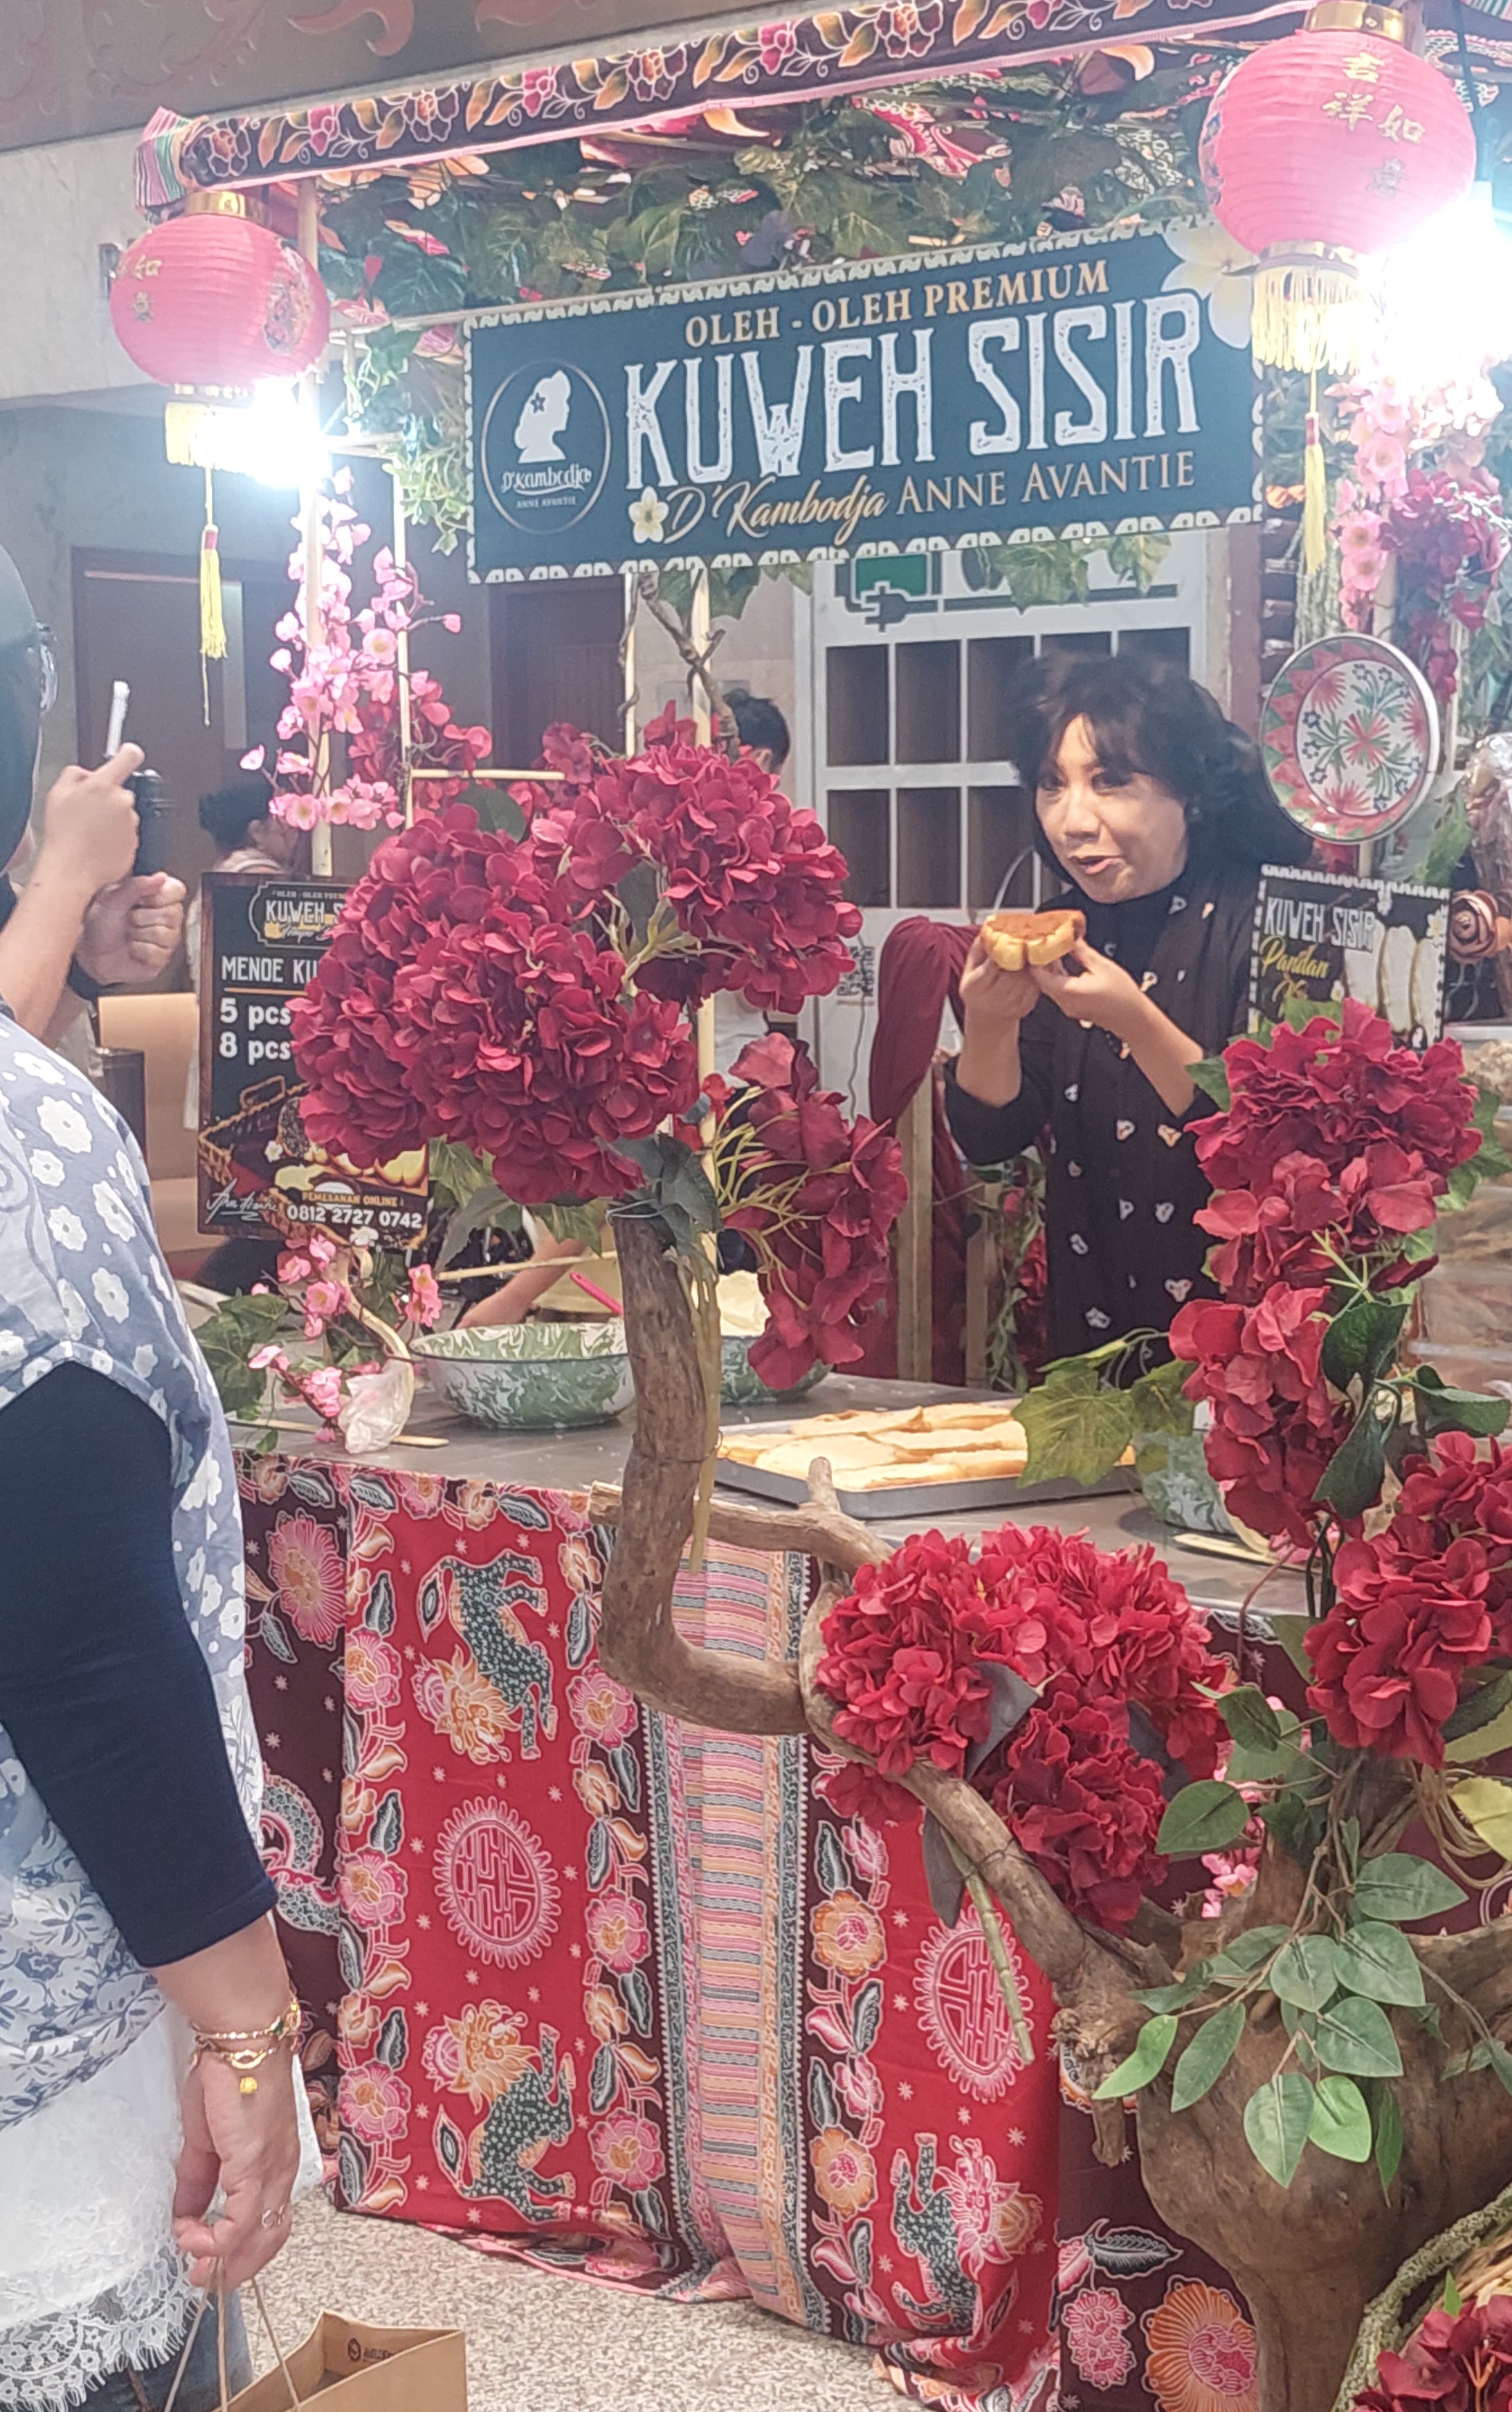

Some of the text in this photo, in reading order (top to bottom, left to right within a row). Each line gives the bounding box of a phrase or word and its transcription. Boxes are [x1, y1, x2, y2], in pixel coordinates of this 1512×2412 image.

[685, 306, 781, 348] OLEH
[812, 289, 912, 332] OLEH
[924, 259, 1109, 318] PREMIUM
[623, 292, 1201, 490] KUWEH SISIR
[663, 450, 1196, 546] D'Kambodja ANNE AVANTIE
[266, 899, 325, 924] KUWEH
[1263, 896, 1376, 952] KUWEH SISIR
[221, 956, 284, 983] MENOE
[1259, 935, 1329, 979] Pandan
[220, 997, 291, 1031] 5 pcs
[219, 1031, 291, 1066] 8 pcs
[302, 1191, 361, 1205] PEMESANAN
[363, 1196, 398, 1207] ONLINE
[287, 1205, 423, 1229] 0812 2727 0742
